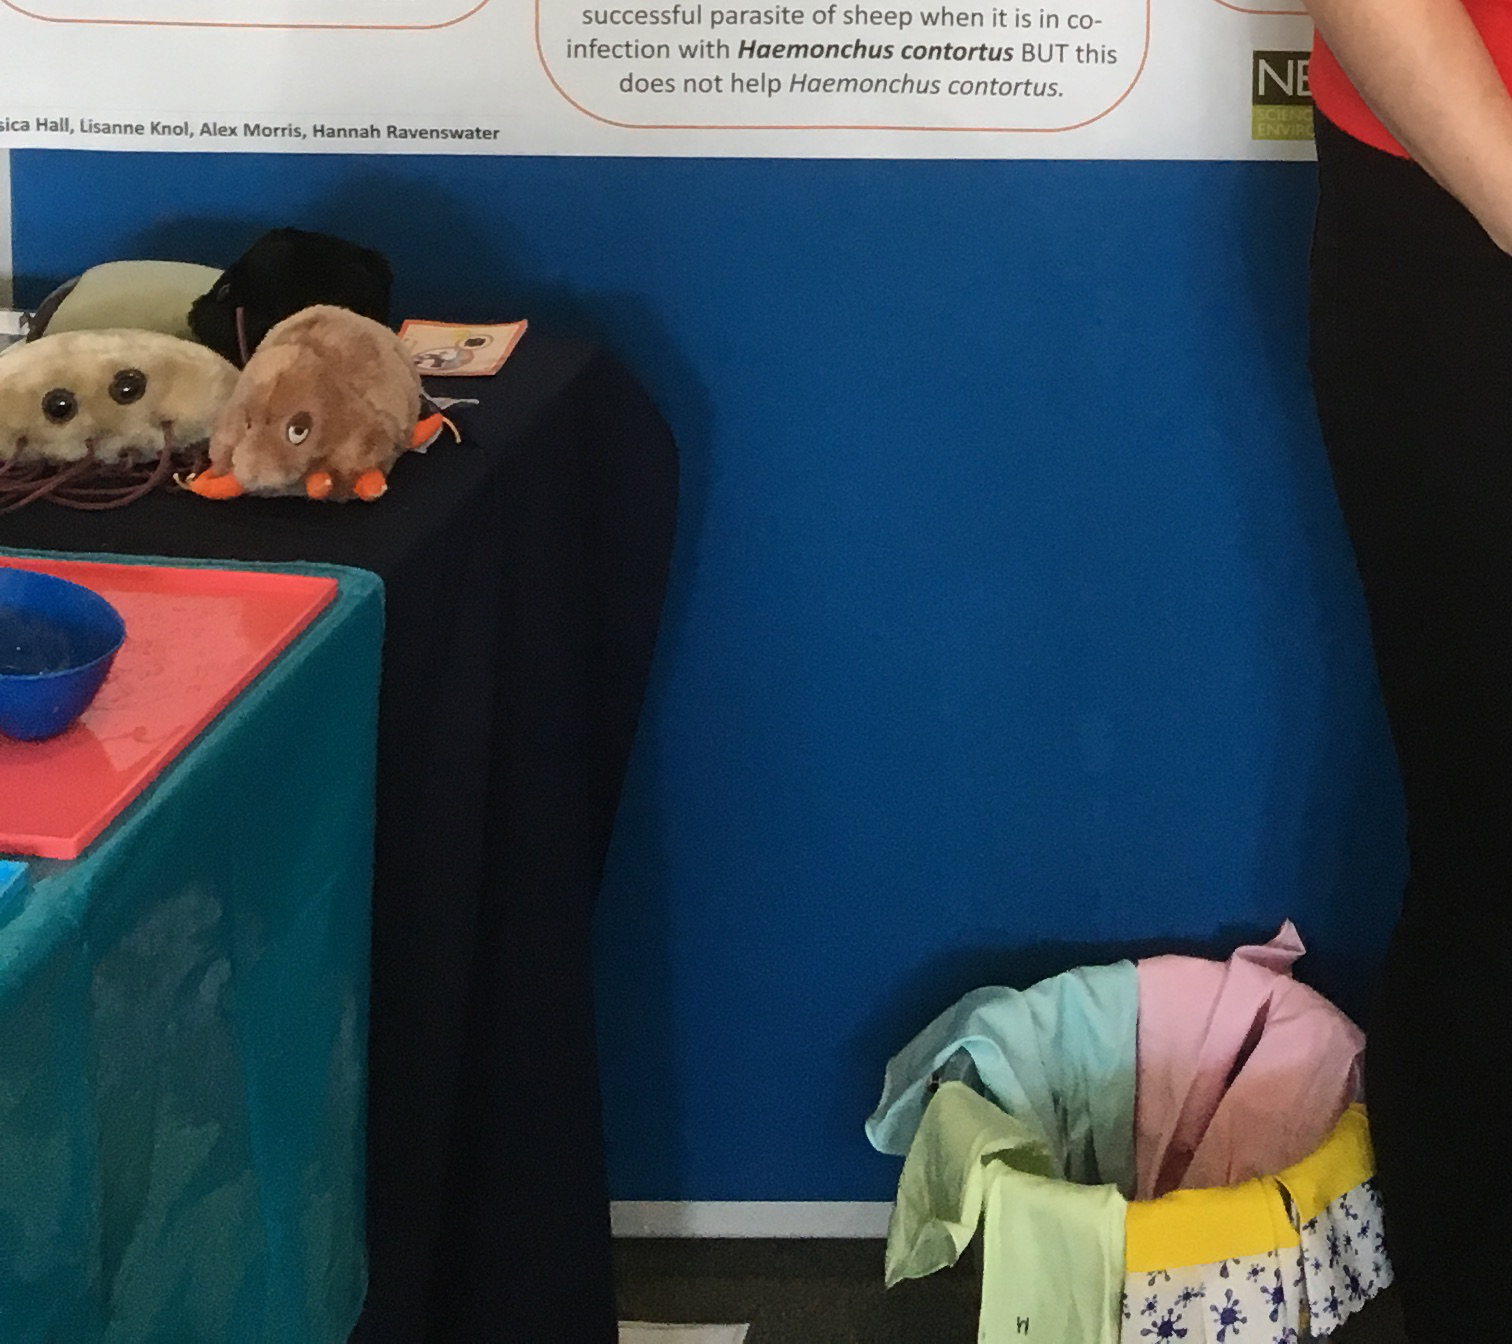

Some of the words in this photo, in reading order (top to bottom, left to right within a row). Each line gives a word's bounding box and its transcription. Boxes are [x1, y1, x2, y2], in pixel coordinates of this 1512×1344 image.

[567, 38, 670, 59] infection
[678, 38, 729, 59] with
[738, 39, 895, 59] Haemonchus
[900, 43, 1014, 61] contortus
[1022, 42, 1069, 63] BUT
[1075, 43, 1117, 64] this
[619, 72, 675, 93] does
[683, 75, 723, 93] not
[730, 72, 781, 97] help
[788, 73, 941, 94] Haemonchus
[948, 78, 1063, 97] contortus.
[35, 117, 75, 134] Hall,
[80, 118, 145, 135] Lisanne
[150, 121, 194, 138] Knol,
[199, 122, 238, 137] Alex
[243, 123, 307, 139] Morris,
[312, 124, 381, 138] Hannah
[386, 125, 500, 140] Ravenswater
